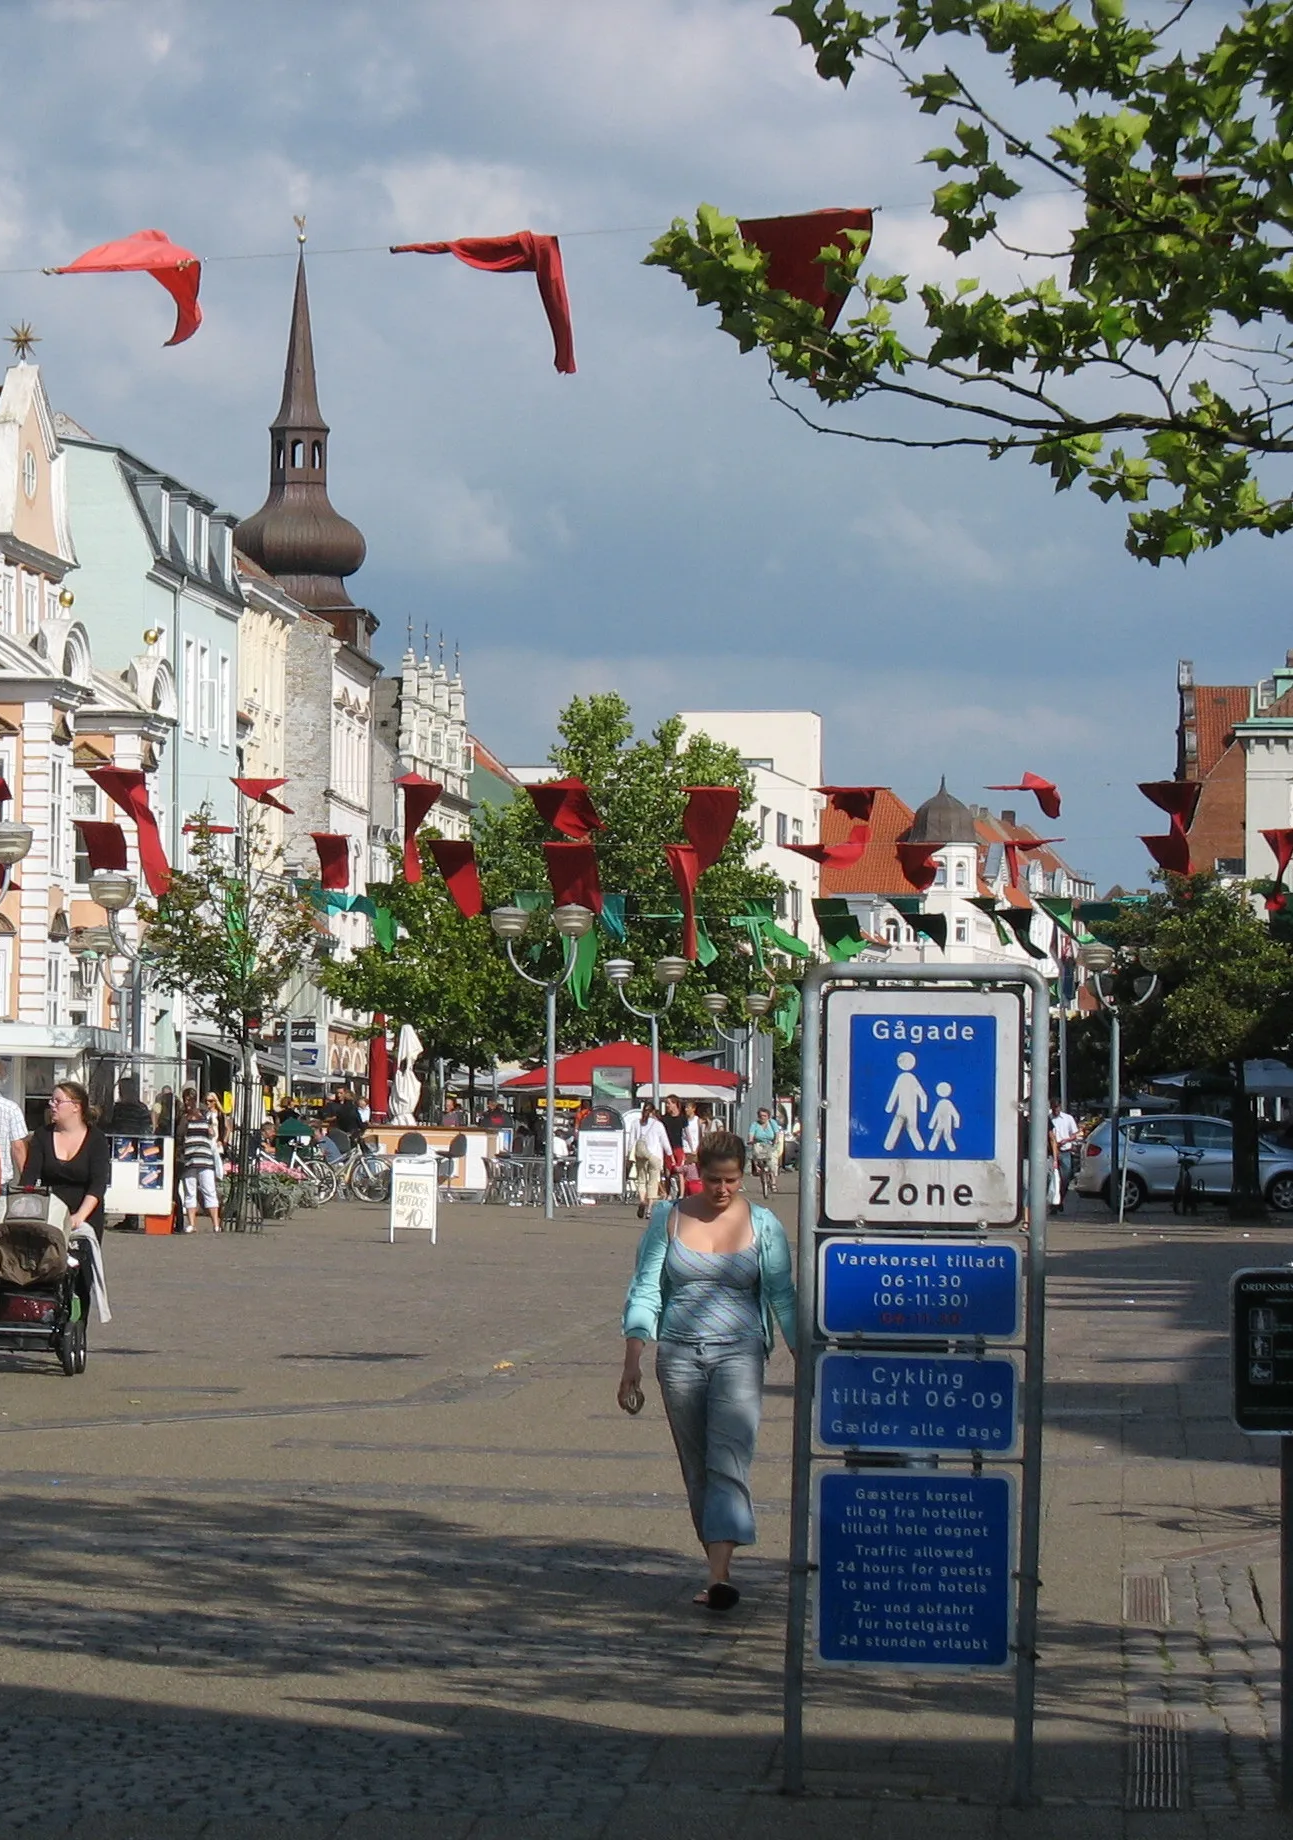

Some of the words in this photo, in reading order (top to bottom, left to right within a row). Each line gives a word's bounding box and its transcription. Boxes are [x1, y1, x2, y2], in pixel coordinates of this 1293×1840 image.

[276, 1028, 316, 1036] TGER
[872, 1020, 974, 1044] Gågade
[868, 1175, 974, 1207] Zone
[836, 1251, 937, 1268] Varekørsel
[946, 1254, 1007, 1269] tilladt
[880, 1274, 962, 1288] 06-11.30
[873, 1292, 969, 1307] (06-11.30)
[871, 1367, 964, 1389] Cykling
[831, 1387, 910, 1406] tilladt
[924, 1390, 1003, 1409] 06-09
[830, 1419, 900, 1435] Gælder
[910, 1422, 945, 1437] alle
[956, 1424, 1002, 1441] dage
[855, 1488, 920, 1502] Gæsters
[925, 1489, 974, 1502] kørsel
[845, 1505, 863, 1518] til
[868, 1508, 887, 1519] og
[894, 1505, 916, 1518] fra
[921, 1506, 984, 1520] hoteller
[840, 1522, 889, 1535] tilladt
[895, 1523, 928, 1536] hele
[934, 1524, 989, 1539] døgnet
[855, 1544, 907, 1557] Traffic
[913, 1546, 974, 1559] allowed
[836, 1560, 856, 1573] 24
[862, 1561, 905, 1574] hours
[911, 1563, 934, 1575] for
[939, 1564, 993, 1578] guests
[841, 1578, 857, 1591] to
[863, 1578, 891, 1591] and
[896, 1579, 932, 1593] from
[937, 1580, 987, 1594] hotels
[852, 1600, 877, 1613] Zu-
[883, 1601, 911, 1614] und
[916, 1602, 976, 1616] abfahrt
[838, 1634, 858, 1647] 24
[865, 1635, 927, 1648] stunden
[932, 1637, 989, 1650] erlaubt
